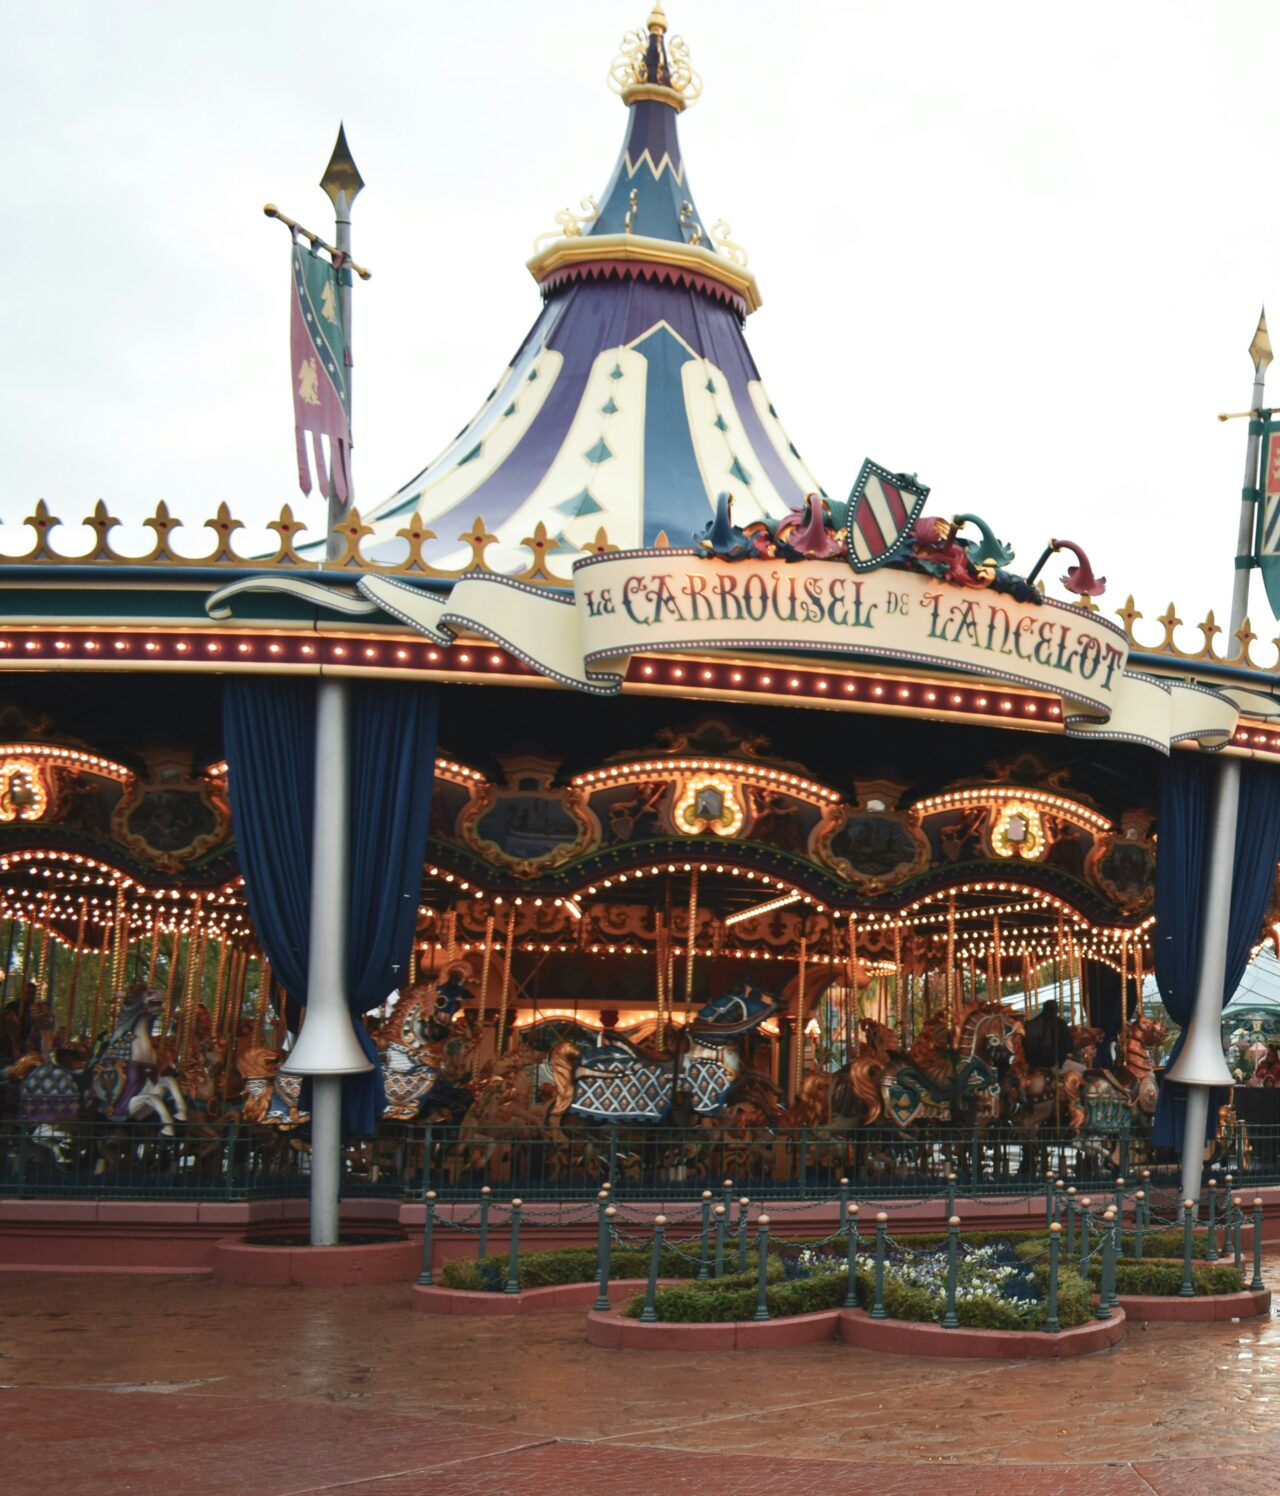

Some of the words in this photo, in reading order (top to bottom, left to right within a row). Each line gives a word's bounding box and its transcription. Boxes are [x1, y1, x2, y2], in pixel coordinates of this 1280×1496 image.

[584, 588, 616, 618] LE
[621, 570, 878, 629] CARROUSEL
[886, 590, 911, 616] DE
[919, 591, 1124, 692] LANCELOT
